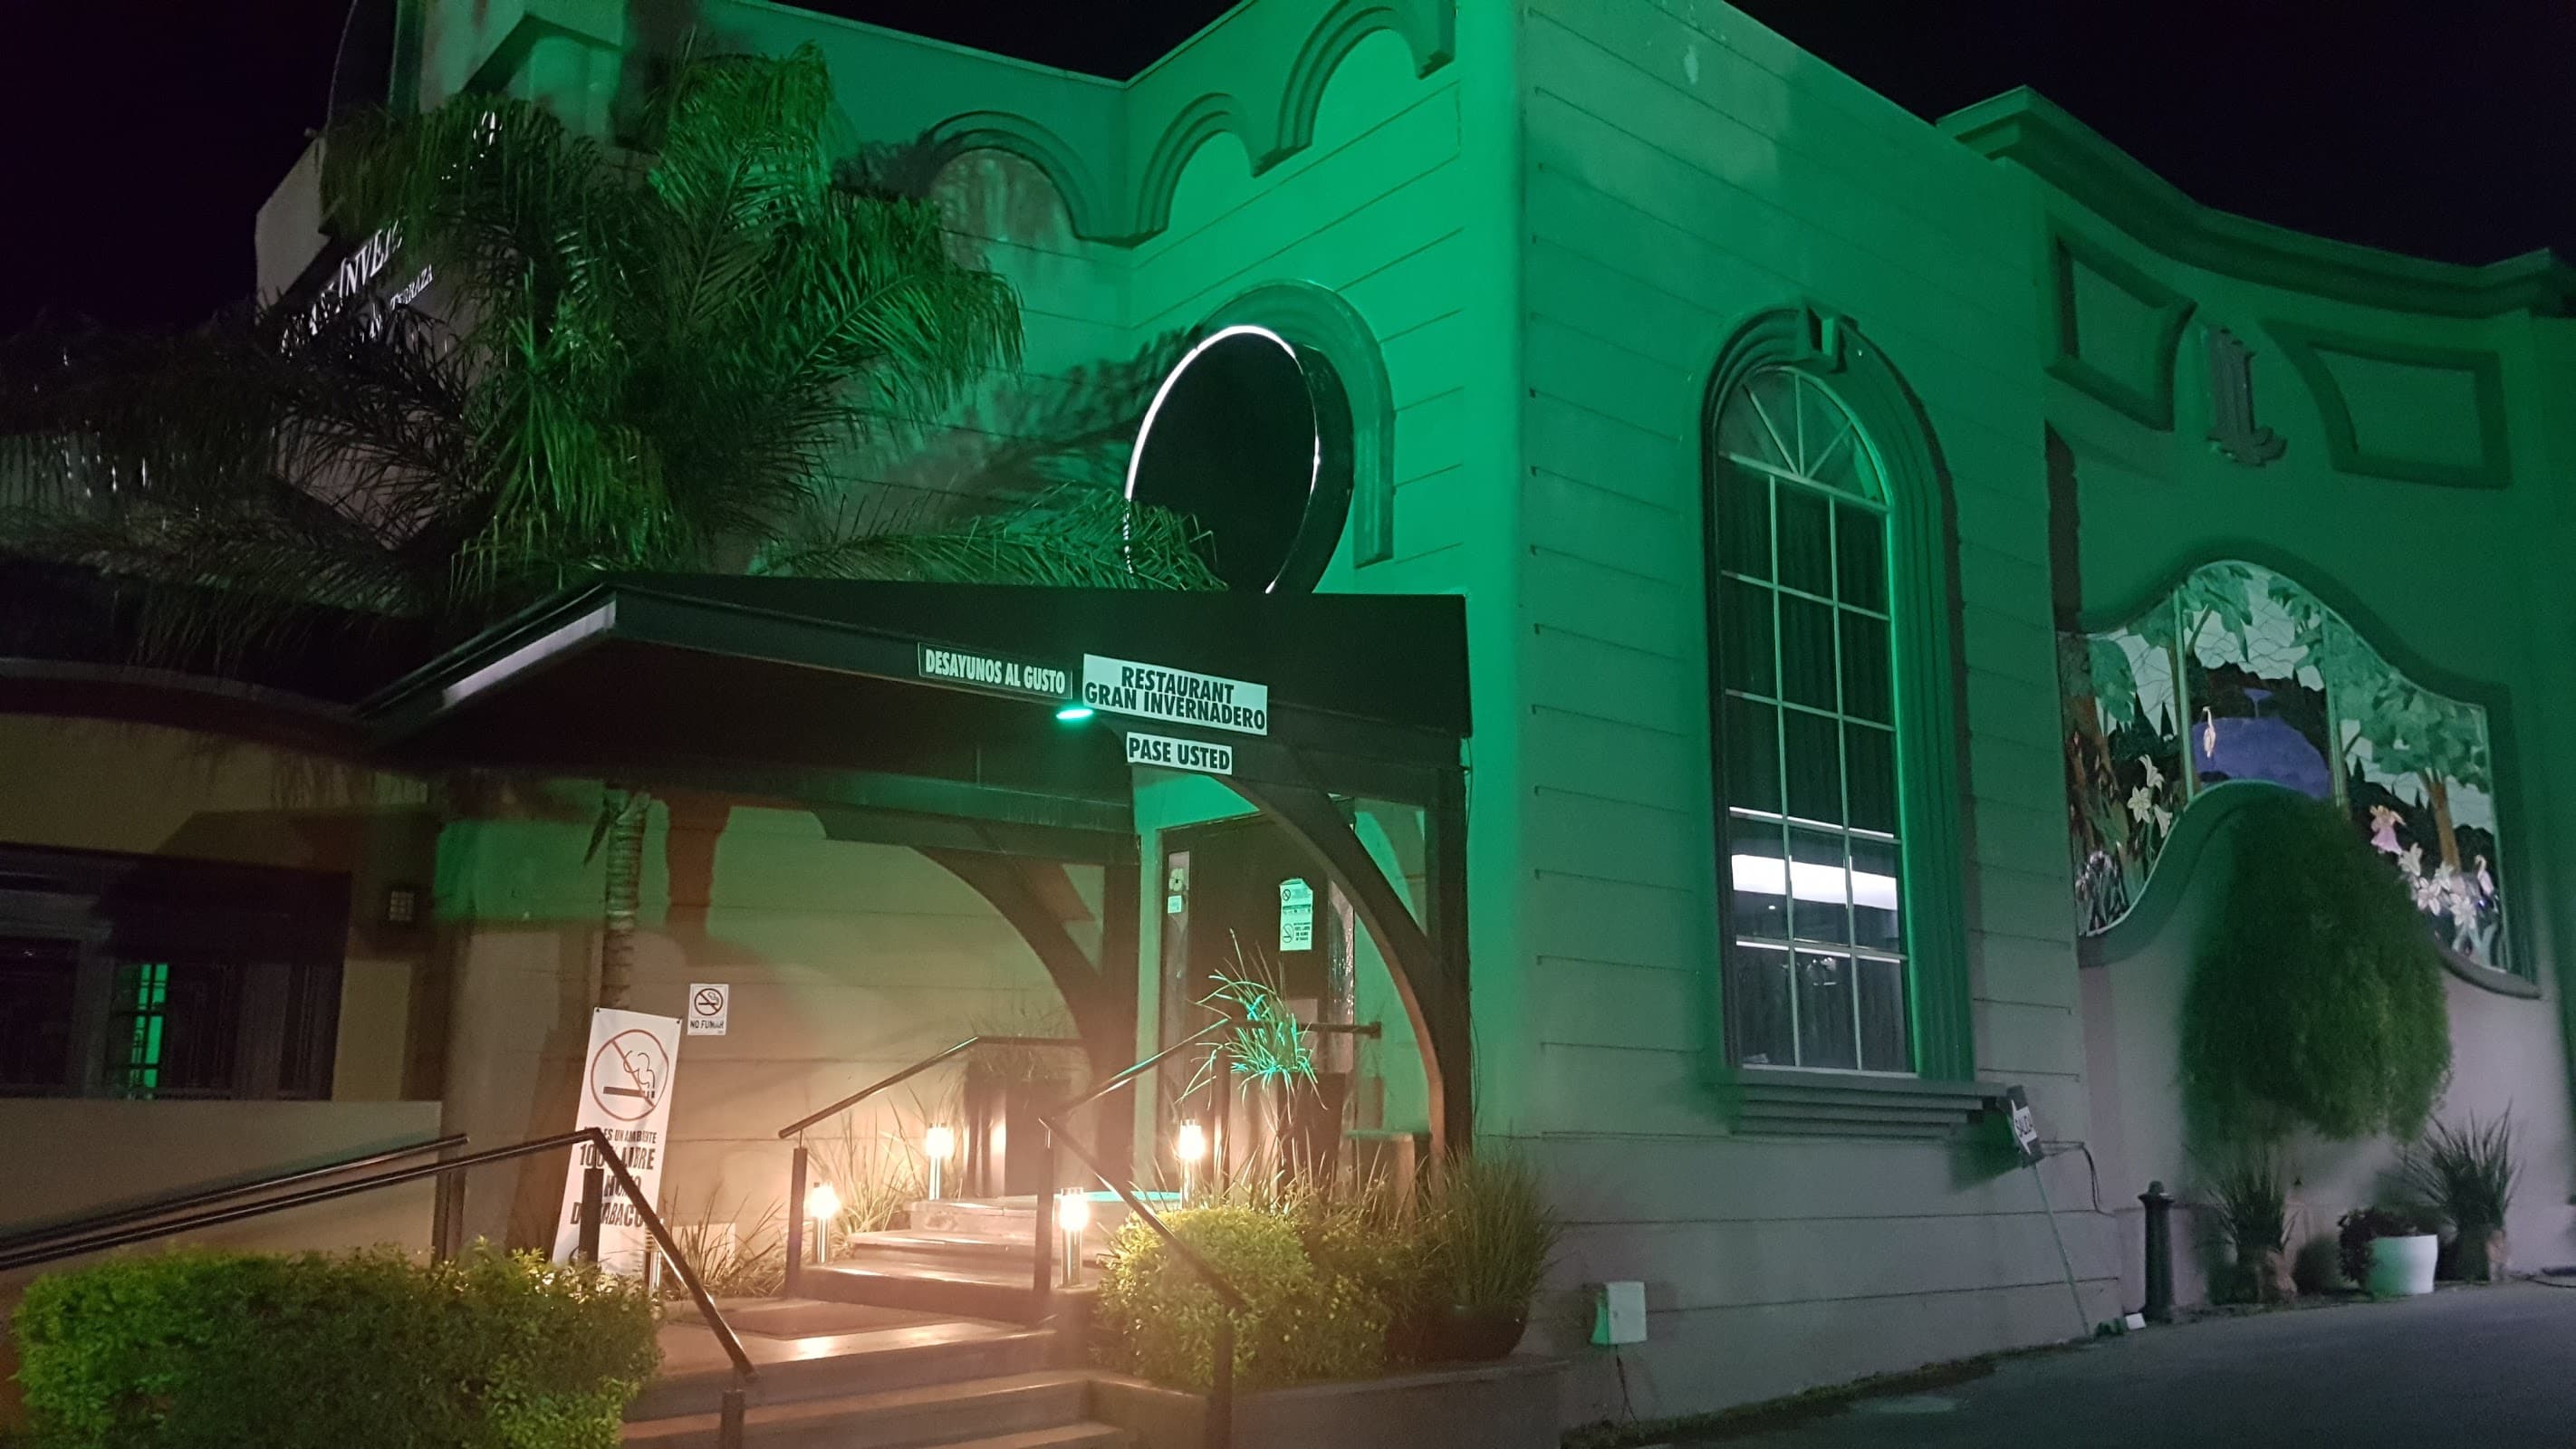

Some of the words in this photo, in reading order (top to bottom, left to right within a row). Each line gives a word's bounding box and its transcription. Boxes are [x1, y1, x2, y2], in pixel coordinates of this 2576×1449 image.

[925, 648, 1003, 684] DESAYUNOS
[1004, 663, 1021, 686] AL
[1024, 666, 1066, 694] GUSTO
[1121, 666, 1235, 704] RESTAURANT
[1084, 682, 1137, 710] GRAN
[1143, 689, 1265, 730] INVERNADERO
[1128, 736, 1171, 763] PASE
[1177, 743, 1230, 770] USTED
[690, 1021, 699, 1029] NO
[700, 1021, 724, 1030] FUMAR
